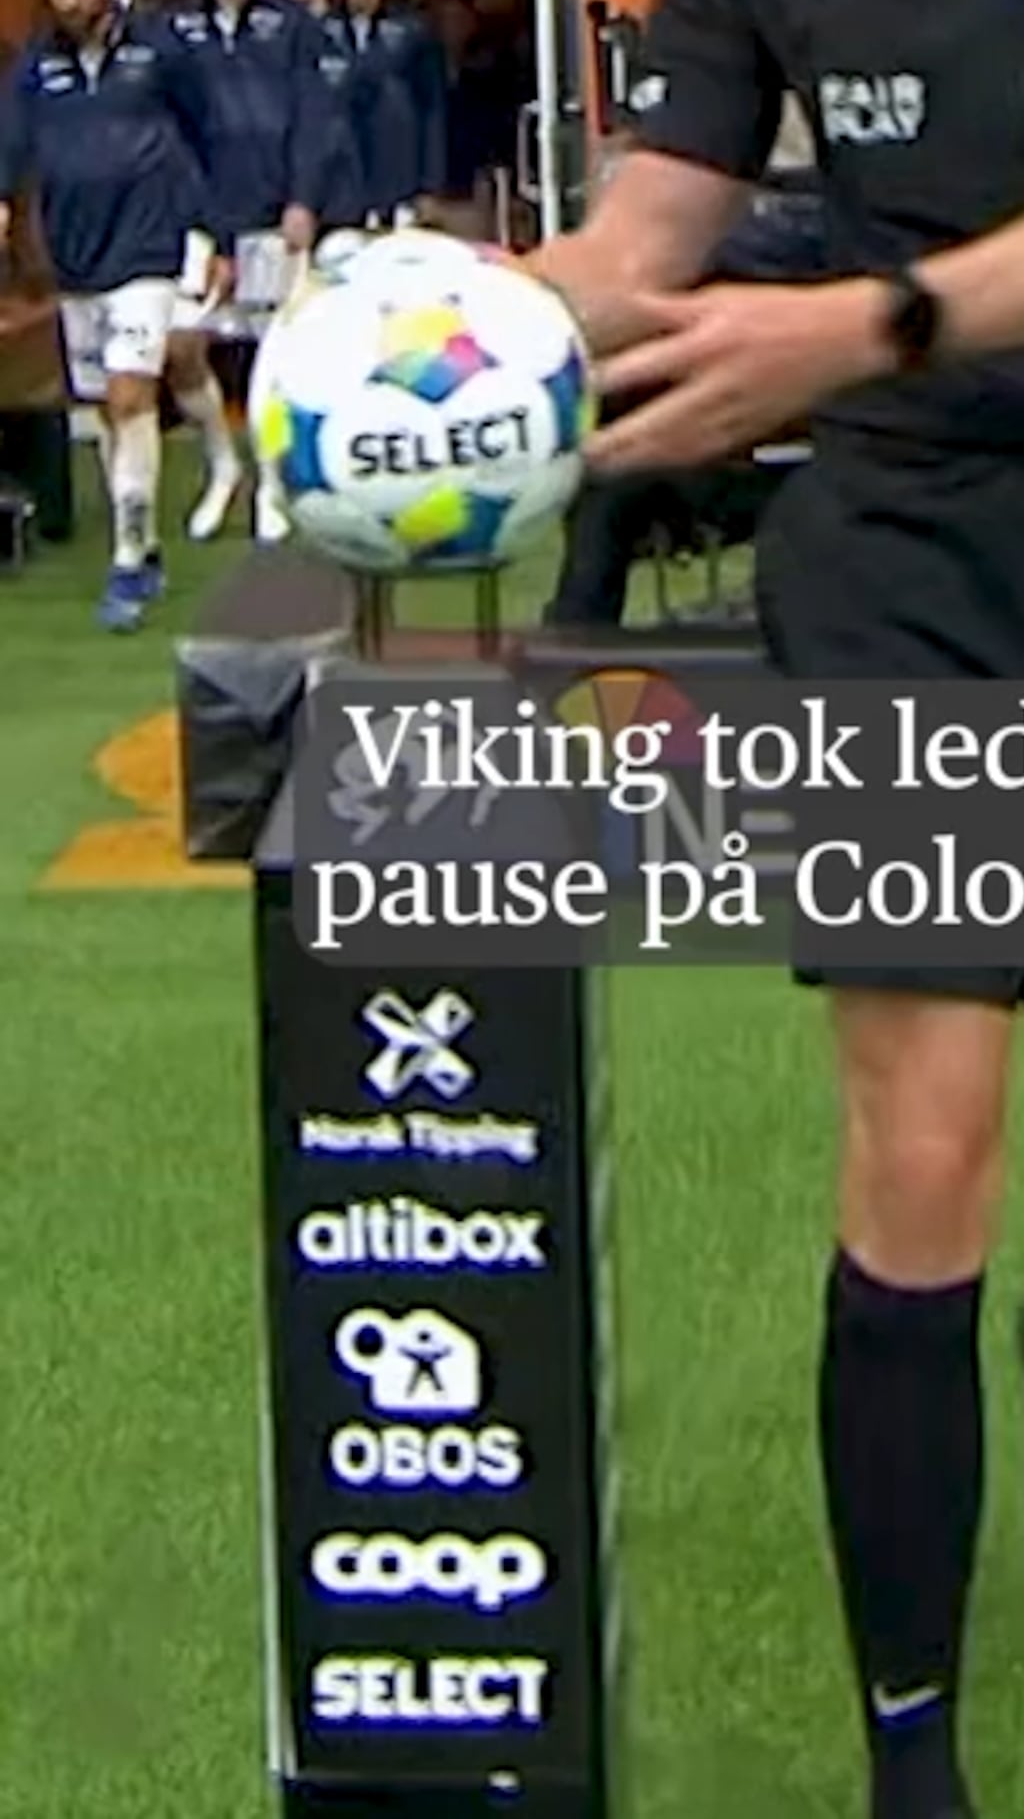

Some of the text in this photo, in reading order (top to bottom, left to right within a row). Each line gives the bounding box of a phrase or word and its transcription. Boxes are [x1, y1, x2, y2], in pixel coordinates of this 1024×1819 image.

[349, 407, 531, 477] SELECT
[298, 1196, 544, 1269] altibox
[330, 1423, 522, 1486] OBOS
[310, 1532, 546, 1611] coop
[312, 1656, 548, 1726] SELECT
